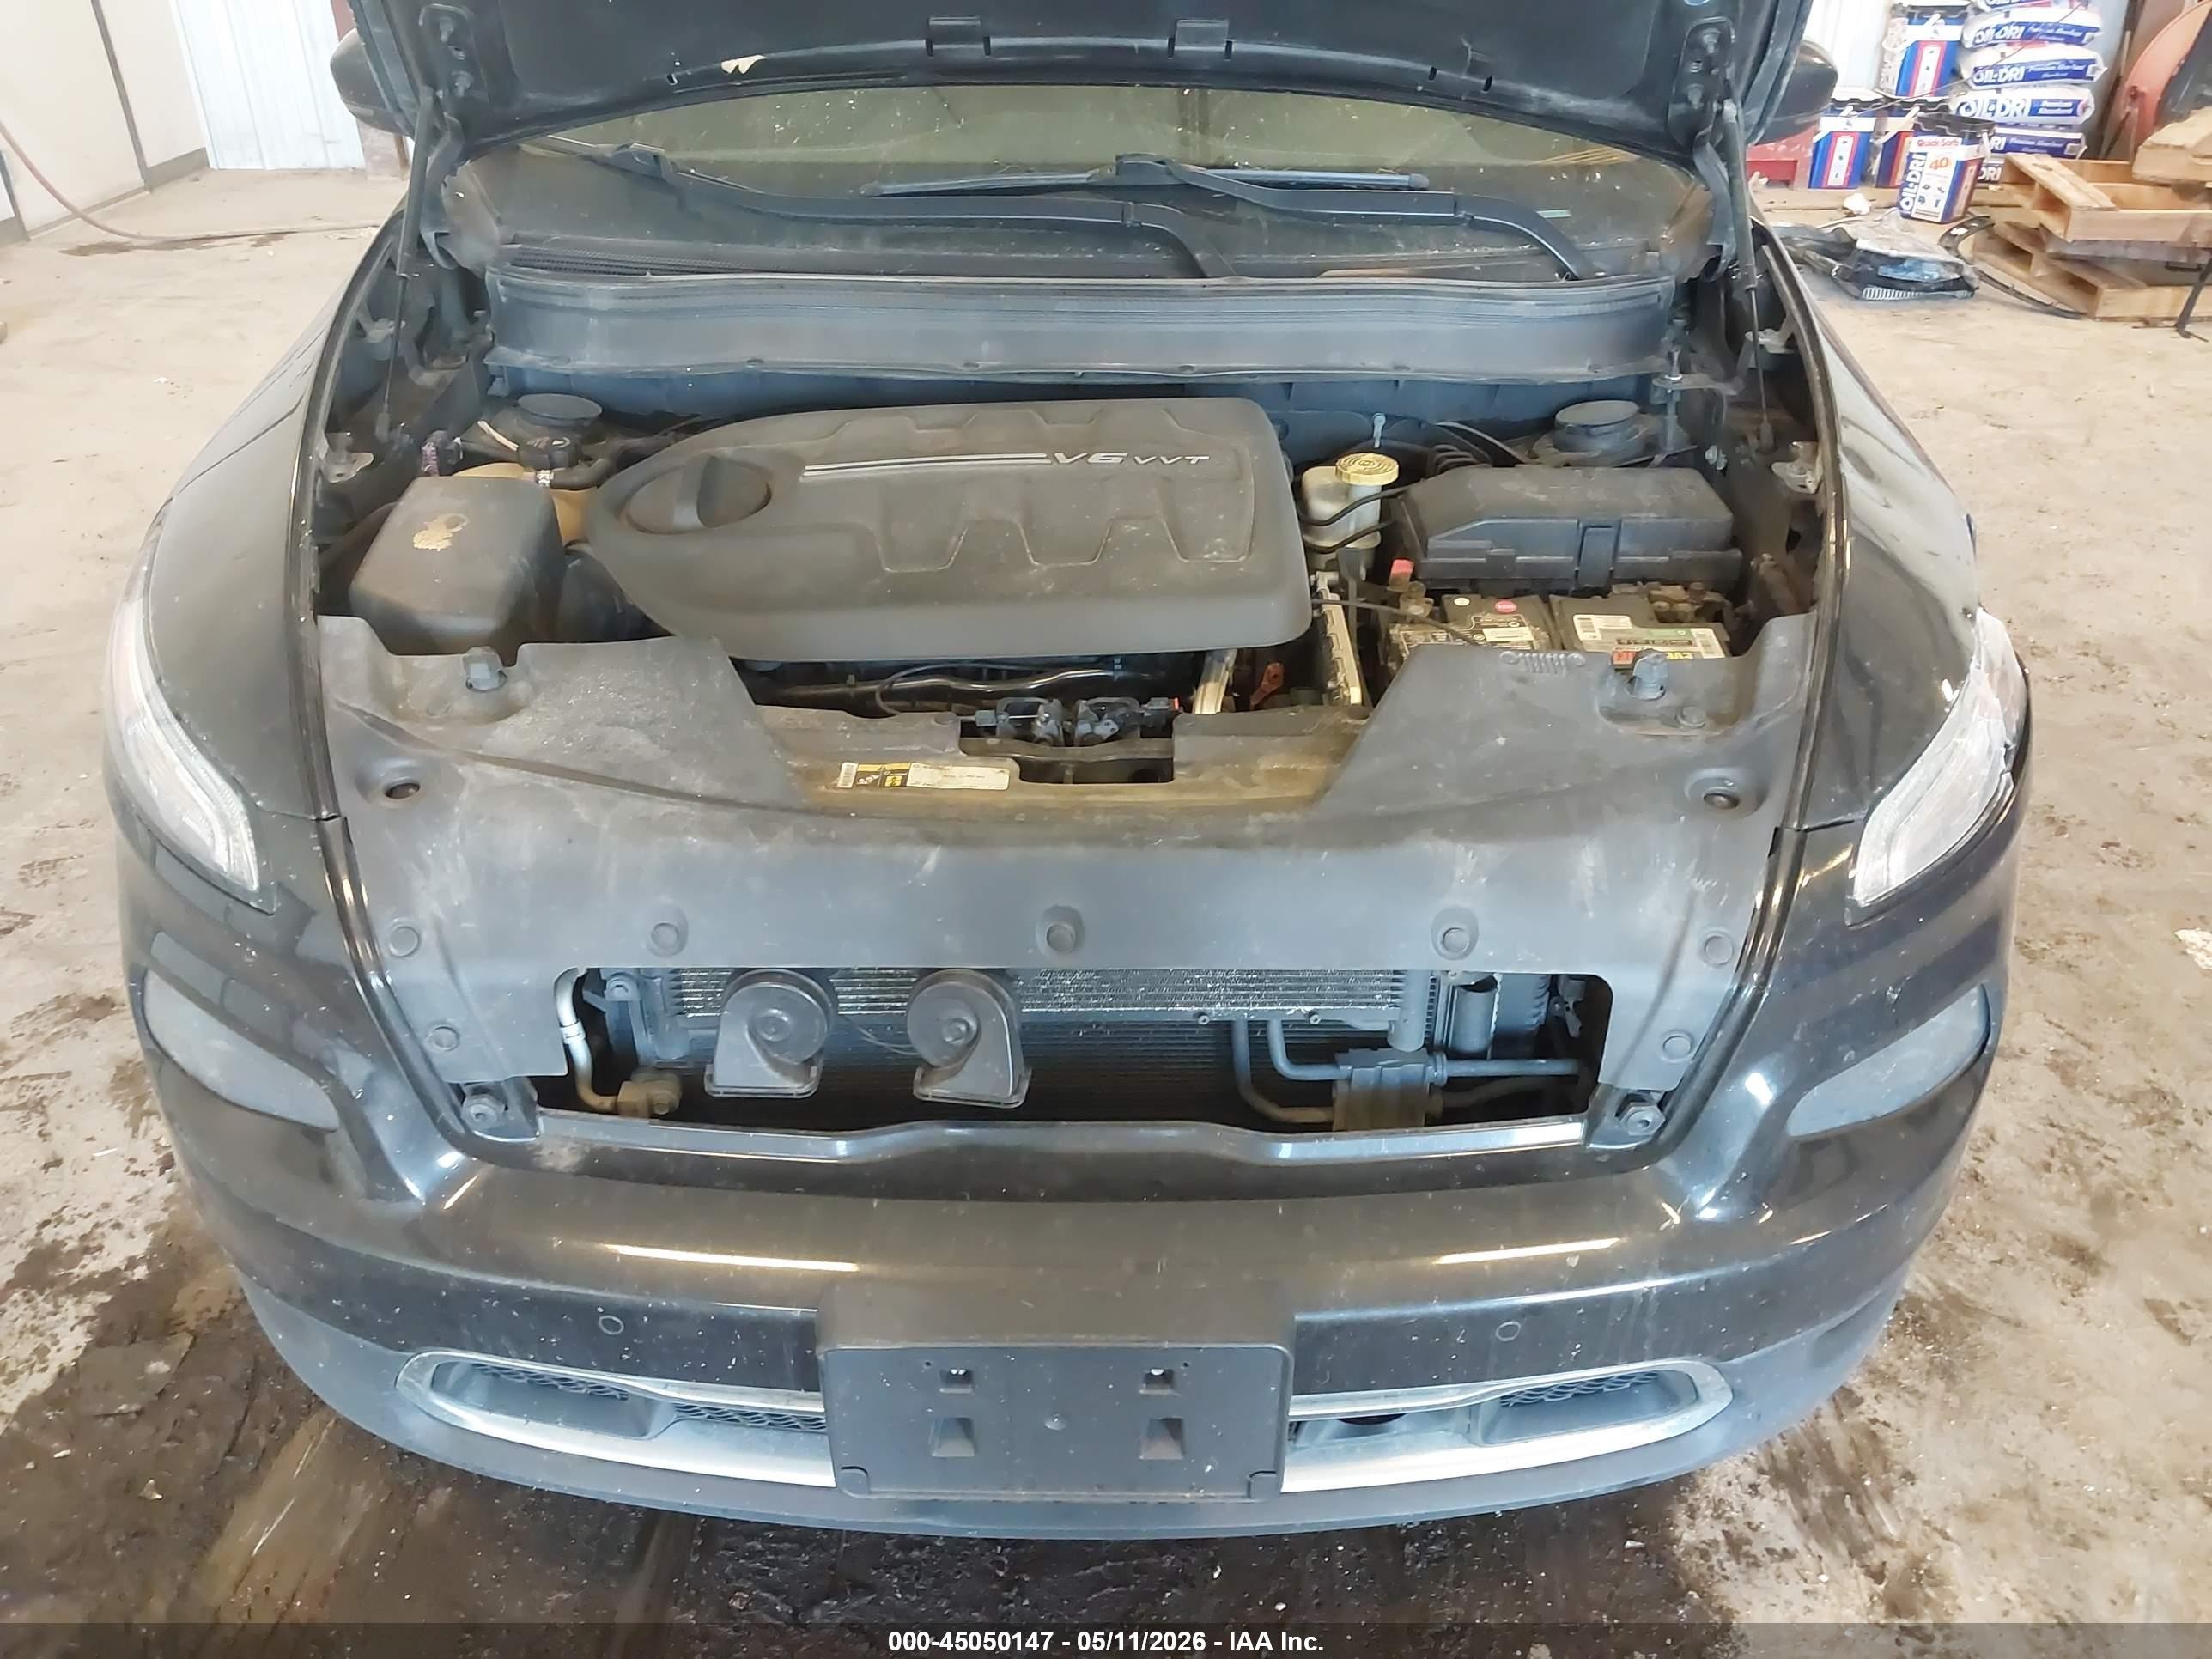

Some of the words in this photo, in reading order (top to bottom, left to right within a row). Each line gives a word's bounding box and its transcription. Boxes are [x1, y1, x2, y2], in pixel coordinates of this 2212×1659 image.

[1899, 153, 1927, 211] OIL-DRI
[1054, 452, 1128, 465] V6
[1133, 455, 1210, 465] VVT
